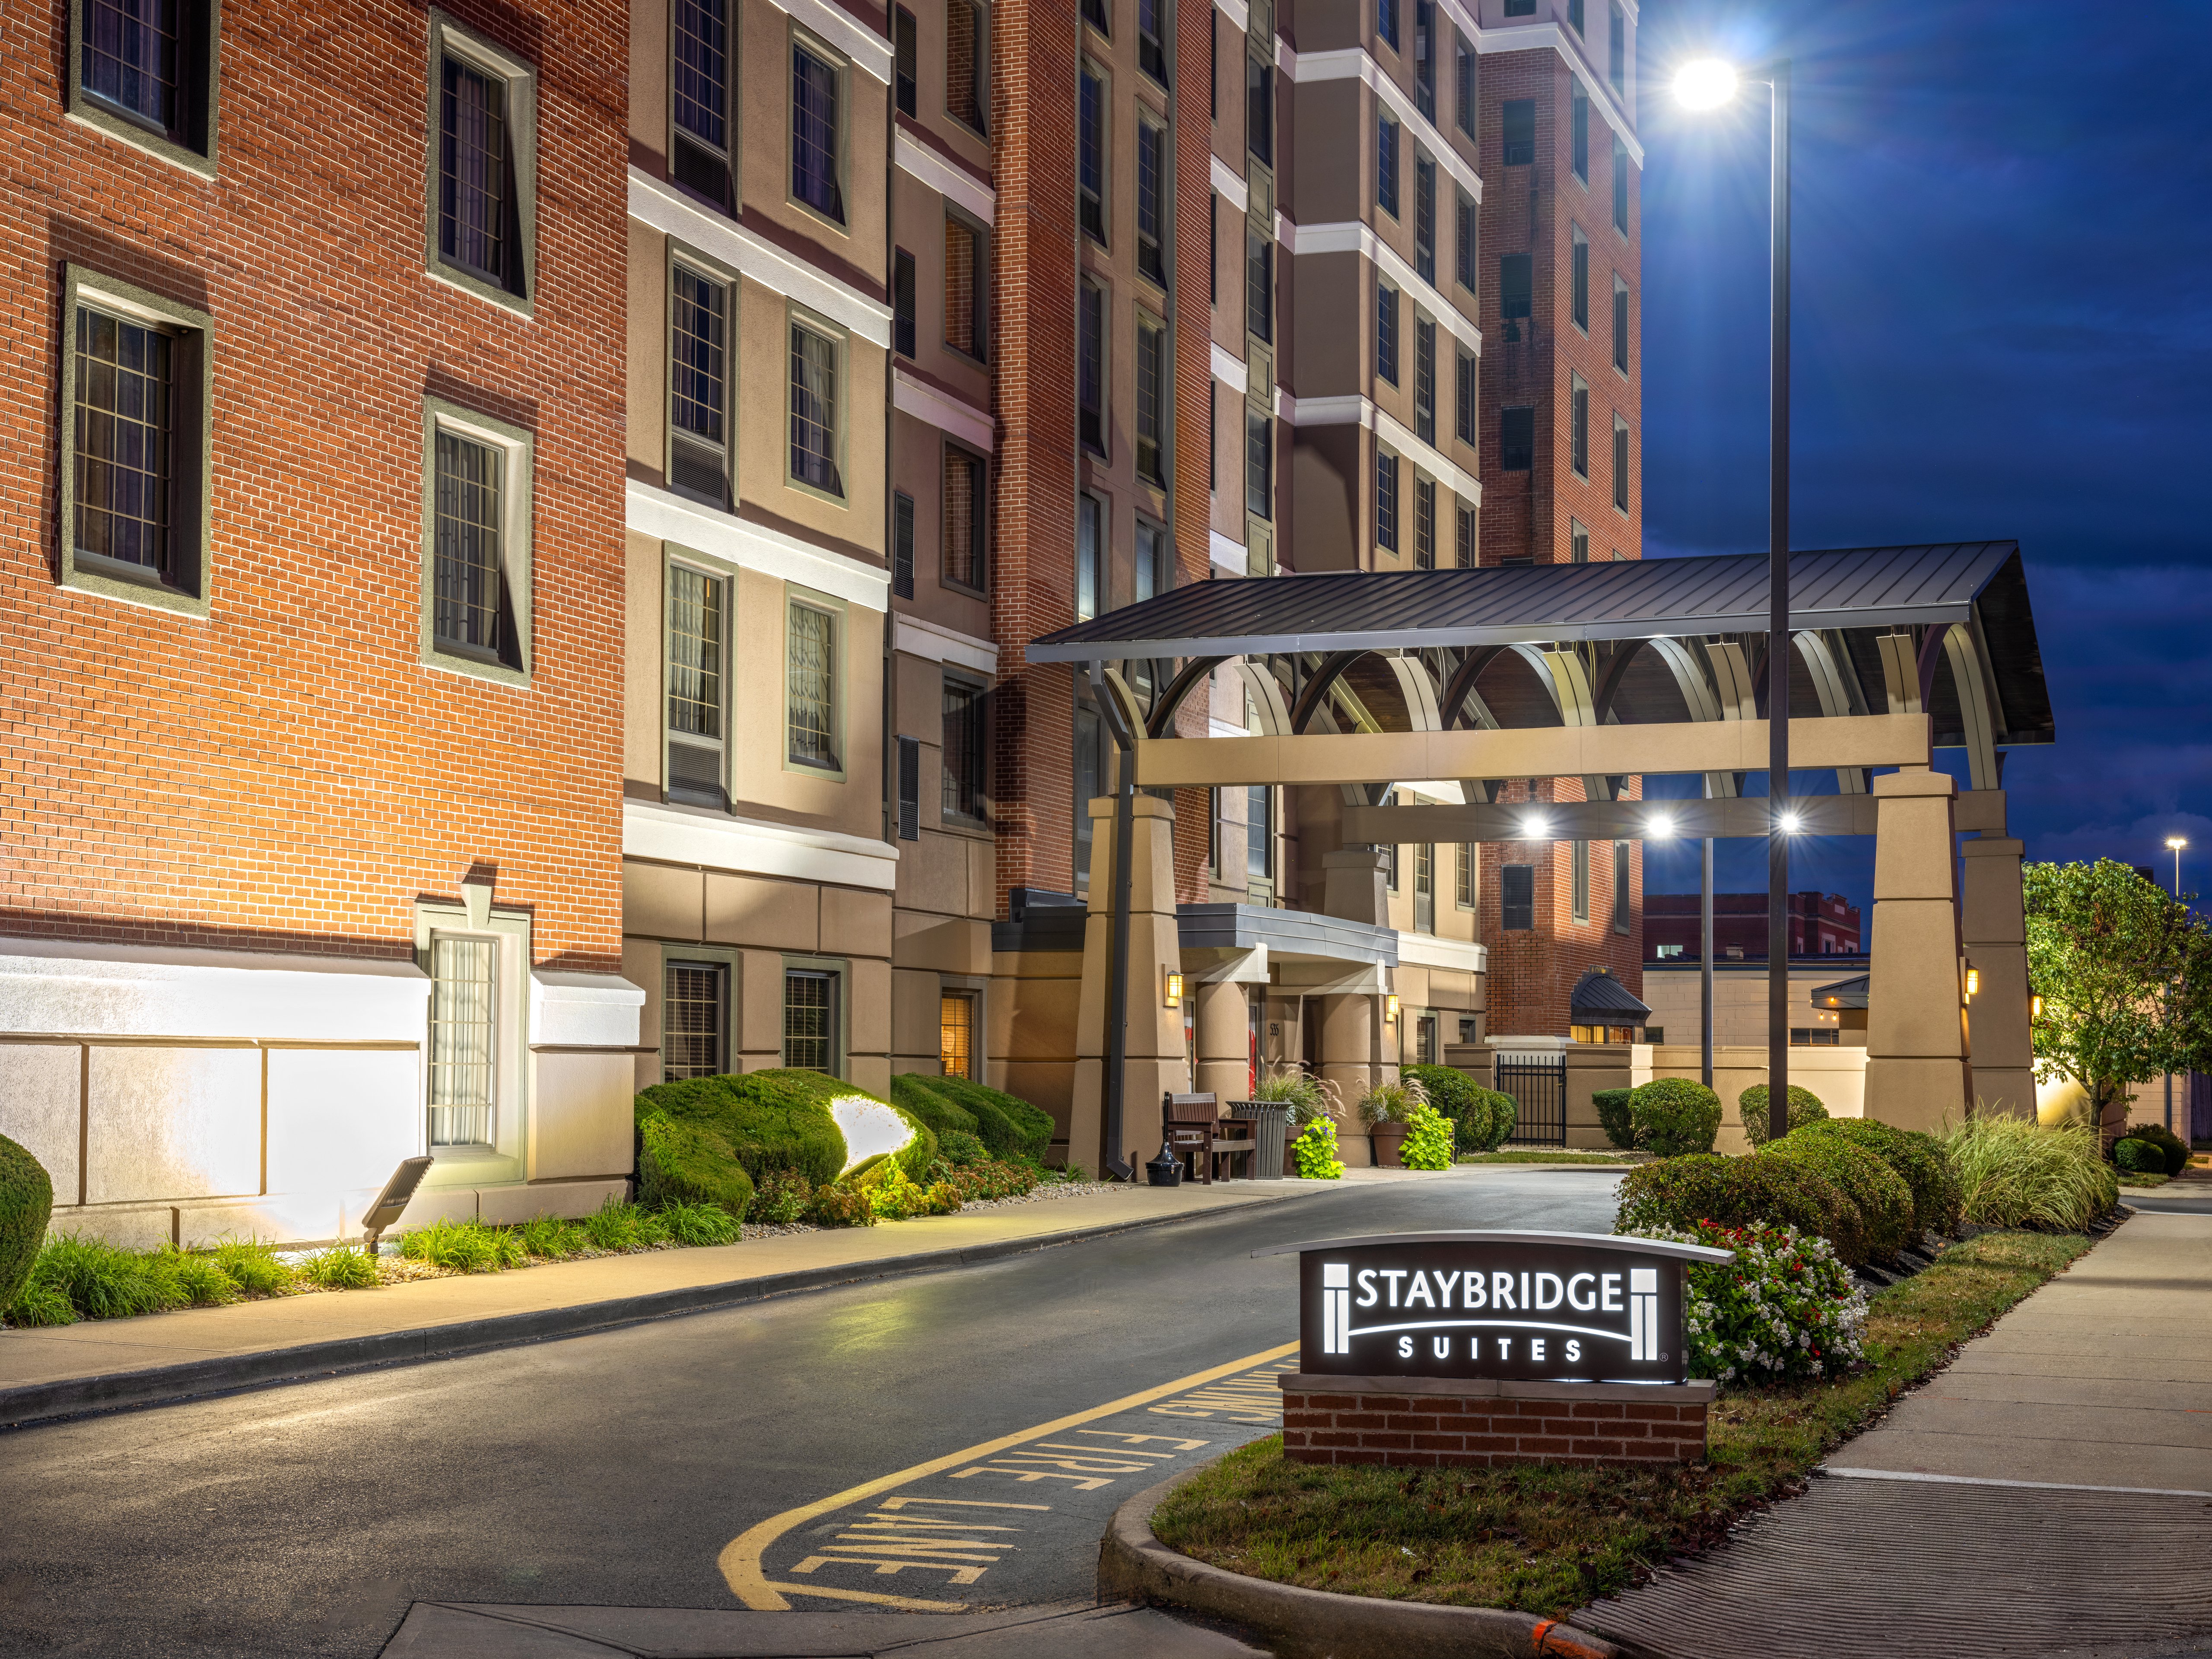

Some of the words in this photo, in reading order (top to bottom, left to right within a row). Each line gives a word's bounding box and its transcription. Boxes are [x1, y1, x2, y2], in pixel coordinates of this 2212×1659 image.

[1270, 1023, 1279, 1036] 535
[1356, 1269, 1624, 1311] STAYBRIDGE
[1398, 1336, 1581, 1362] SUITES
[947, 1430, 1211, 1490] FIRE
[788, 1496, 1052, 1584] LANE
